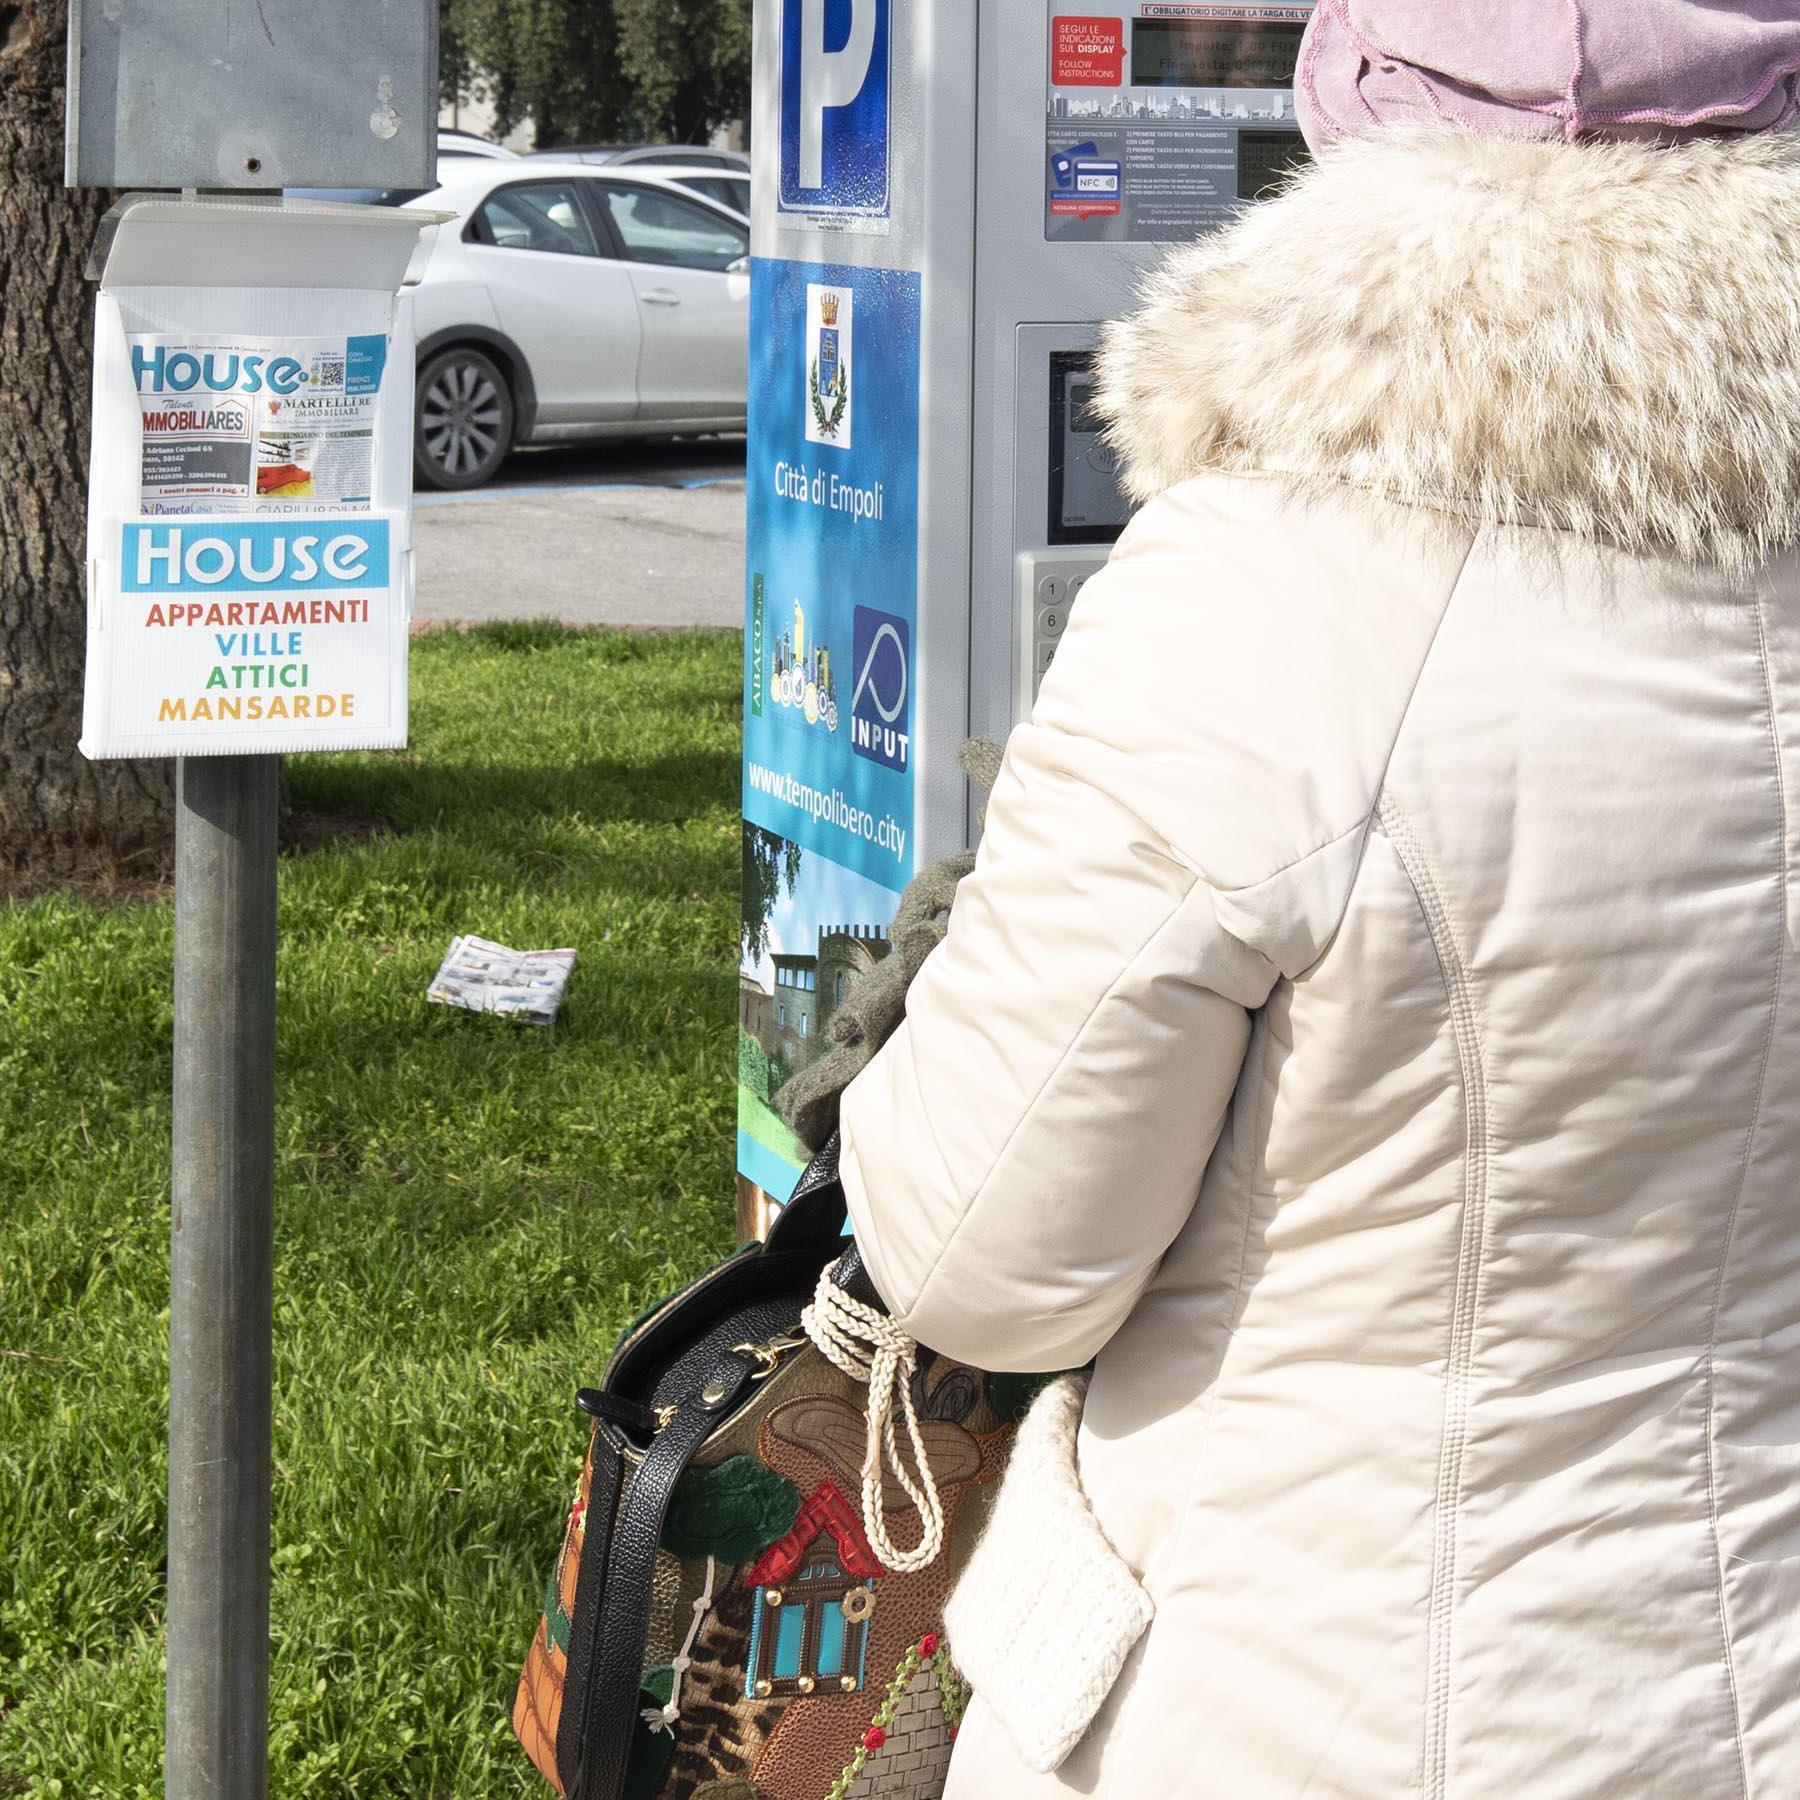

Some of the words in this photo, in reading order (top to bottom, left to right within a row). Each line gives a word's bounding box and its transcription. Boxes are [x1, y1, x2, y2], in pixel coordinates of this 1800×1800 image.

[1152, 7, 1210, 15] OBBLIGATORIO
[1211, 8, 1246, 16] DIGITARE
[1259, 9, 1284, 17] TARGA
[1285, 10, 1298, 18] DEL
[1059, 25, 1087, 34] SEGUI
[1089, 26, 1099, 34] LE
[1059, 34, 1115, 44] INDICAZIONI
[1059, 44, 1075, 52] SUL
[1077, 44, 1114, 53] DISPLAY
[1059, 60, 1093, 68] FOLLOW
[1059, 69, 1115, 78] INSTRUCTIONS
[1080, 178, 1099, 187] NFC
[283, 397, 356, 409] MARTELLI
[294, 407, 358, 417] IMMOBILIARE
[143, 411, 243, 432] MMOBILIARES
[775, 460, 808, 503] Città
[811, 470, 826, 505] di
[829, 473, 883, 523] Empoli
[1050, 583, 1055, 595] 1
[145, 599, 368, 627] APPARTAMENTI
[1047, 615, 1056, 627] 6
[215, 632, 303, 657] VILLE
[753, 620, 761, 708] ABACO
[206, 664, 308, 689] ATTICI
[157, 693, 355, 722] MANSARDE
[851, 715, 909, 763] INPUT
[748, 760, 907, 863] www.tempolibero.city
